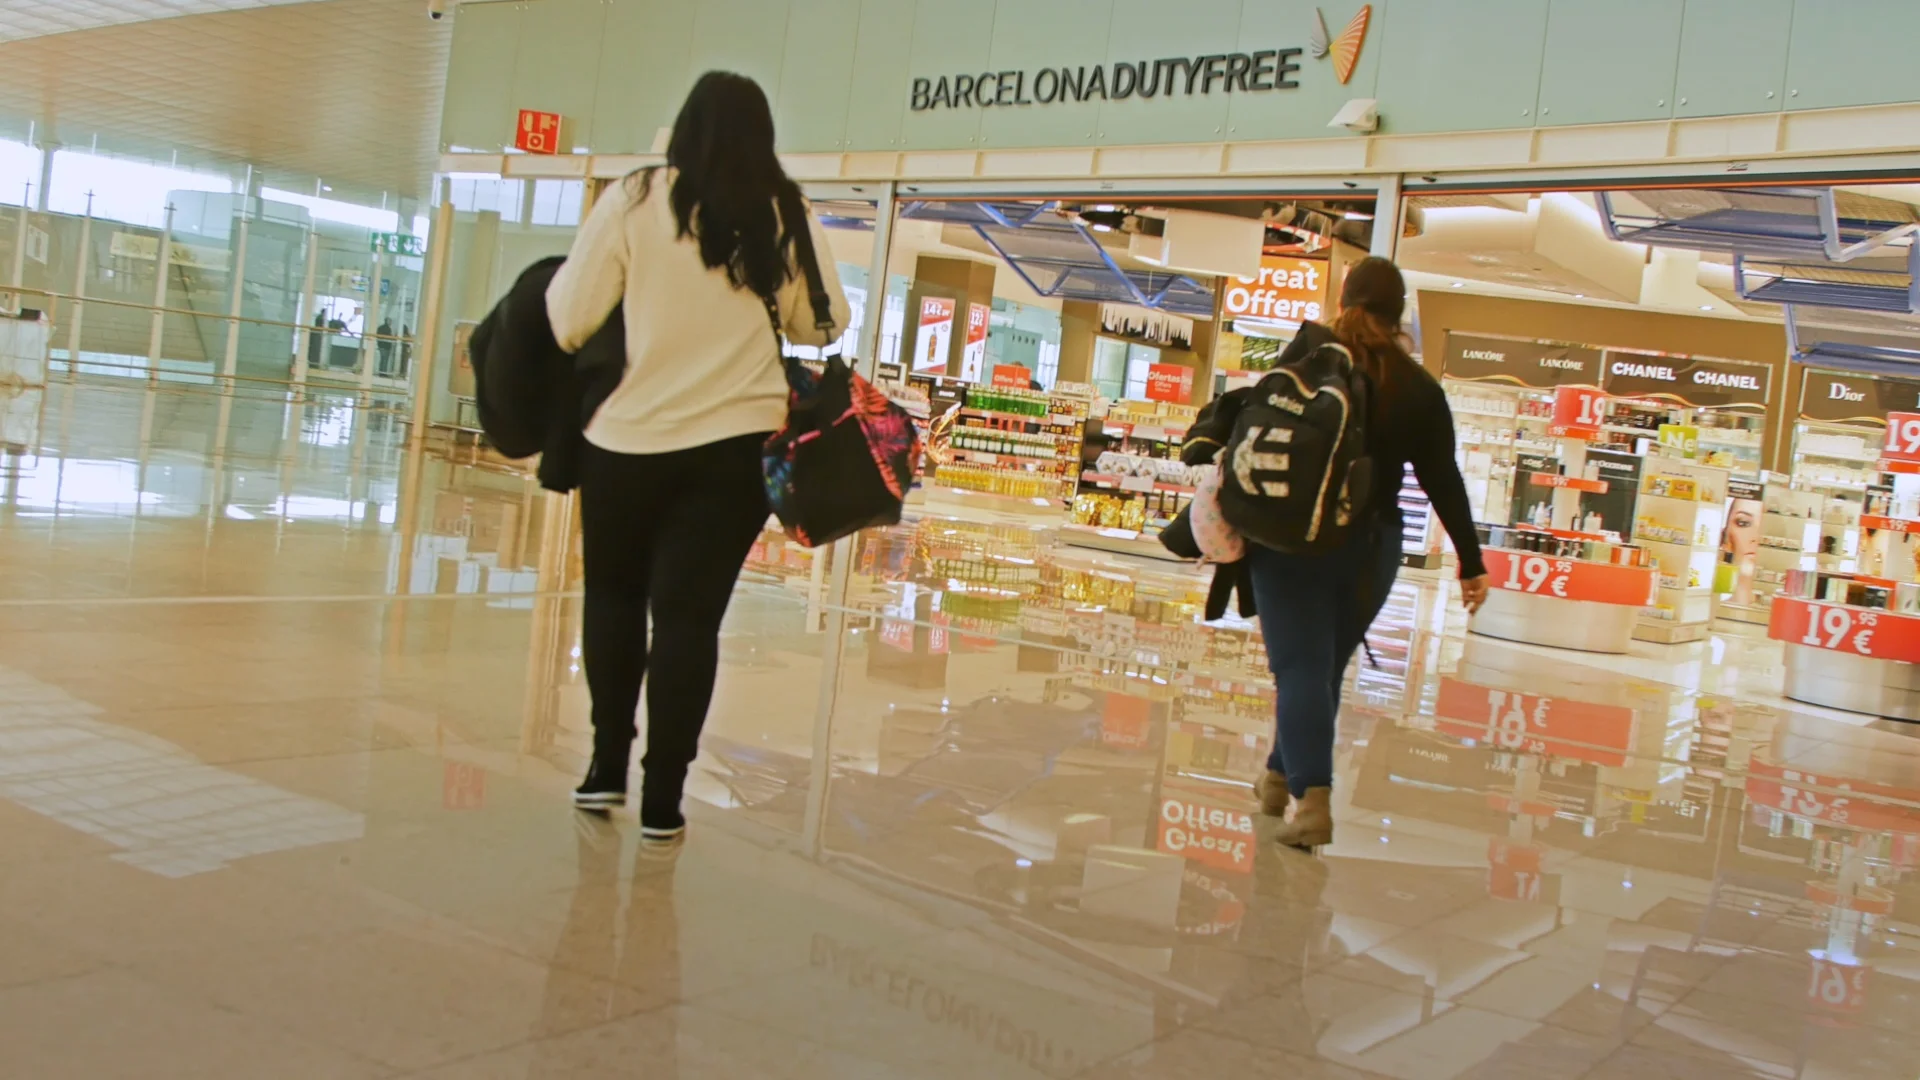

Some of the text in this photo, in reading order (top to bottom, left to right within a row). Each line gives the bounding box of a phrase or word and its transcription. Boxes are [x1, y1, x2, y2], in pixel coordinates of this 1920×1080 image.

[910, 47, 1303, 112] BARCELONADUTYFREE
[1237, 266, 1320, 291] reat
[1226, 287, 1320, 320] Offers
[1611, 361, 1760, 390] CHANEL CHANEL
[1828, 382, 1866, 402] Dior
[1576, 394, 1606, 426] 19
[1885, 418, 1920, 454] 19
